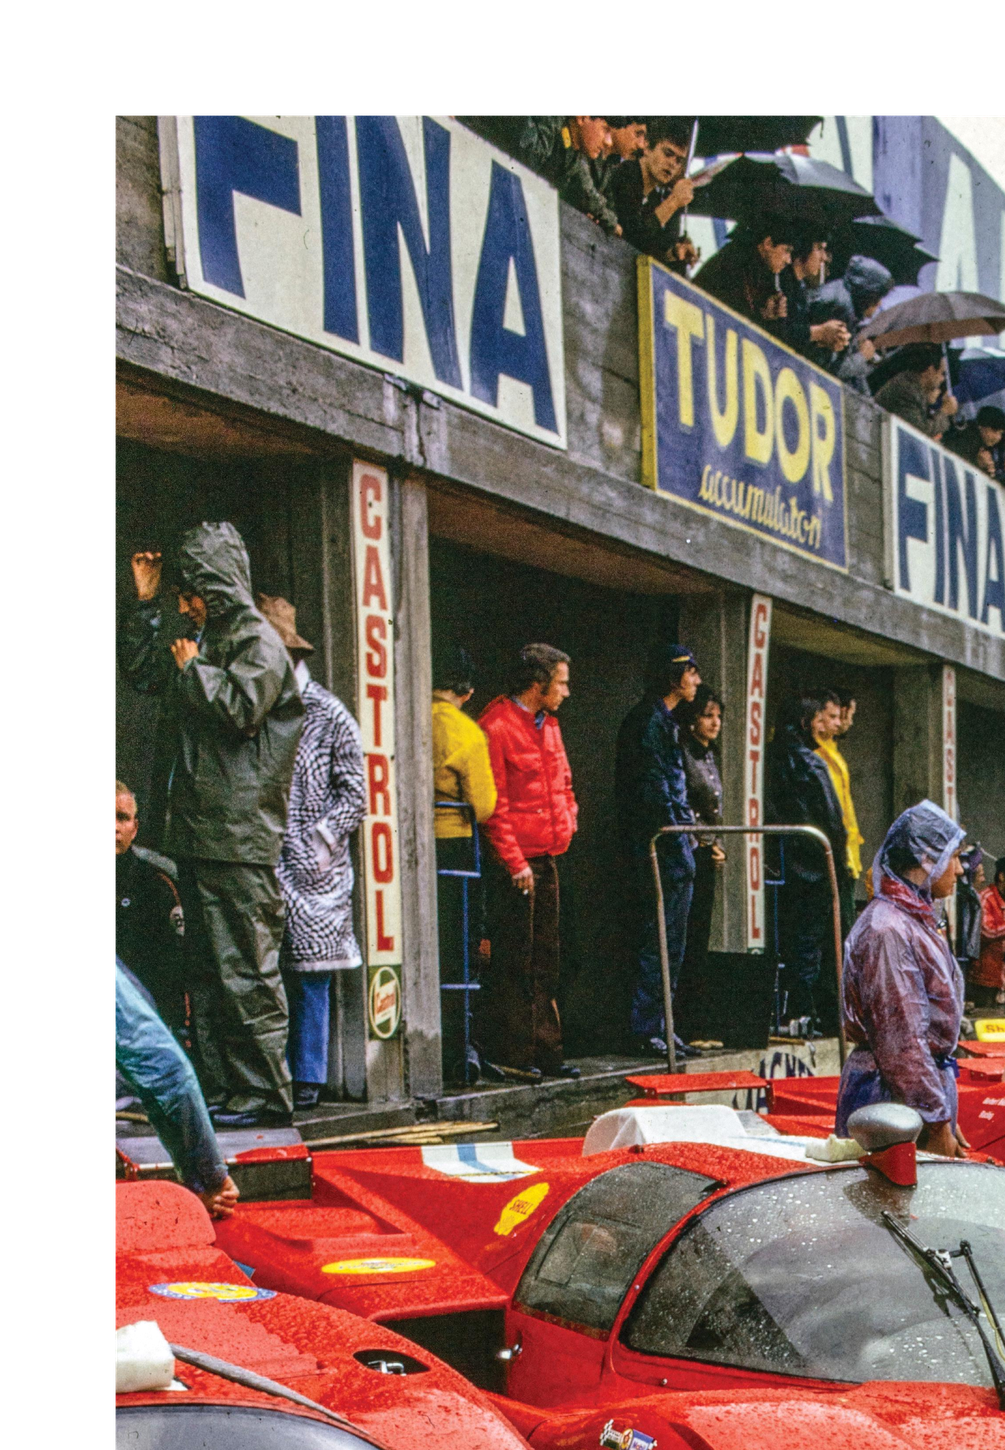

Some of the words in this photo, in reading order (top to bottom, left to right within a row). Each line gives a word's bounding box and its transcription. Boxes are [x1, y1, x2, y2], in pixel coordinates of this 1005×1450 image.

[194, 114, 560, 435] FINA
[664, 290, 836, 503] TUDOR
[359, 473, 396, 952] CASTROL
[748, 603, 768, 939] CASTROL
